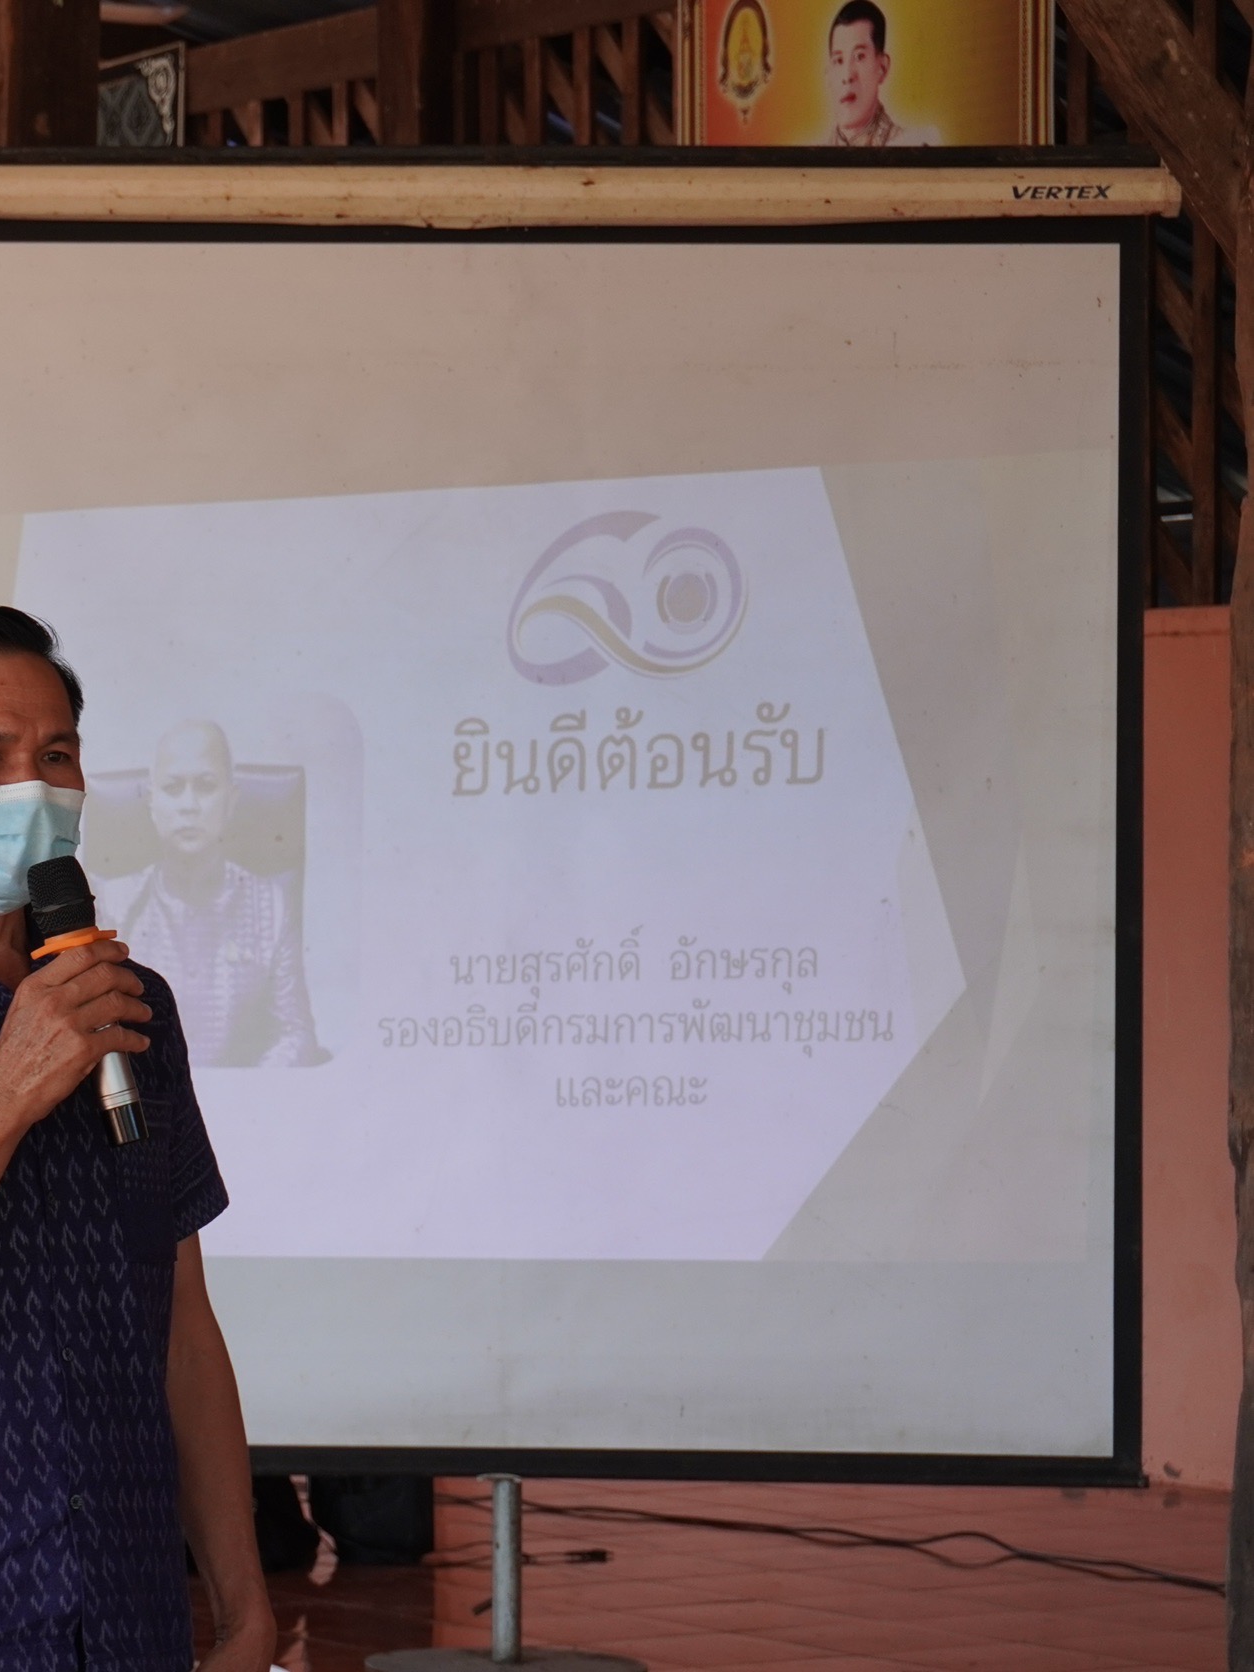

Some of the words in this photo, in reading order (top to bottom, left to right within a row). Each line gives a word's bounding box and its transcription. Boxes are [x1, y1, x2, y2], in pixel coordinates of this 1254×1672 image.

[1012, 184, 1111, 199] VERTEX
[452, 702, 826, 797] ยินดีต้อนรับ
[449, 924, 644, 998] นายสุรศักดิ์
[669, 935, 820, 994] อักษรกุล
[378, 999, 895, 1058] รองอธิบดีกรมการพัฒนาชุมชน
[554, 1074, 708, 1108] และคณะ
